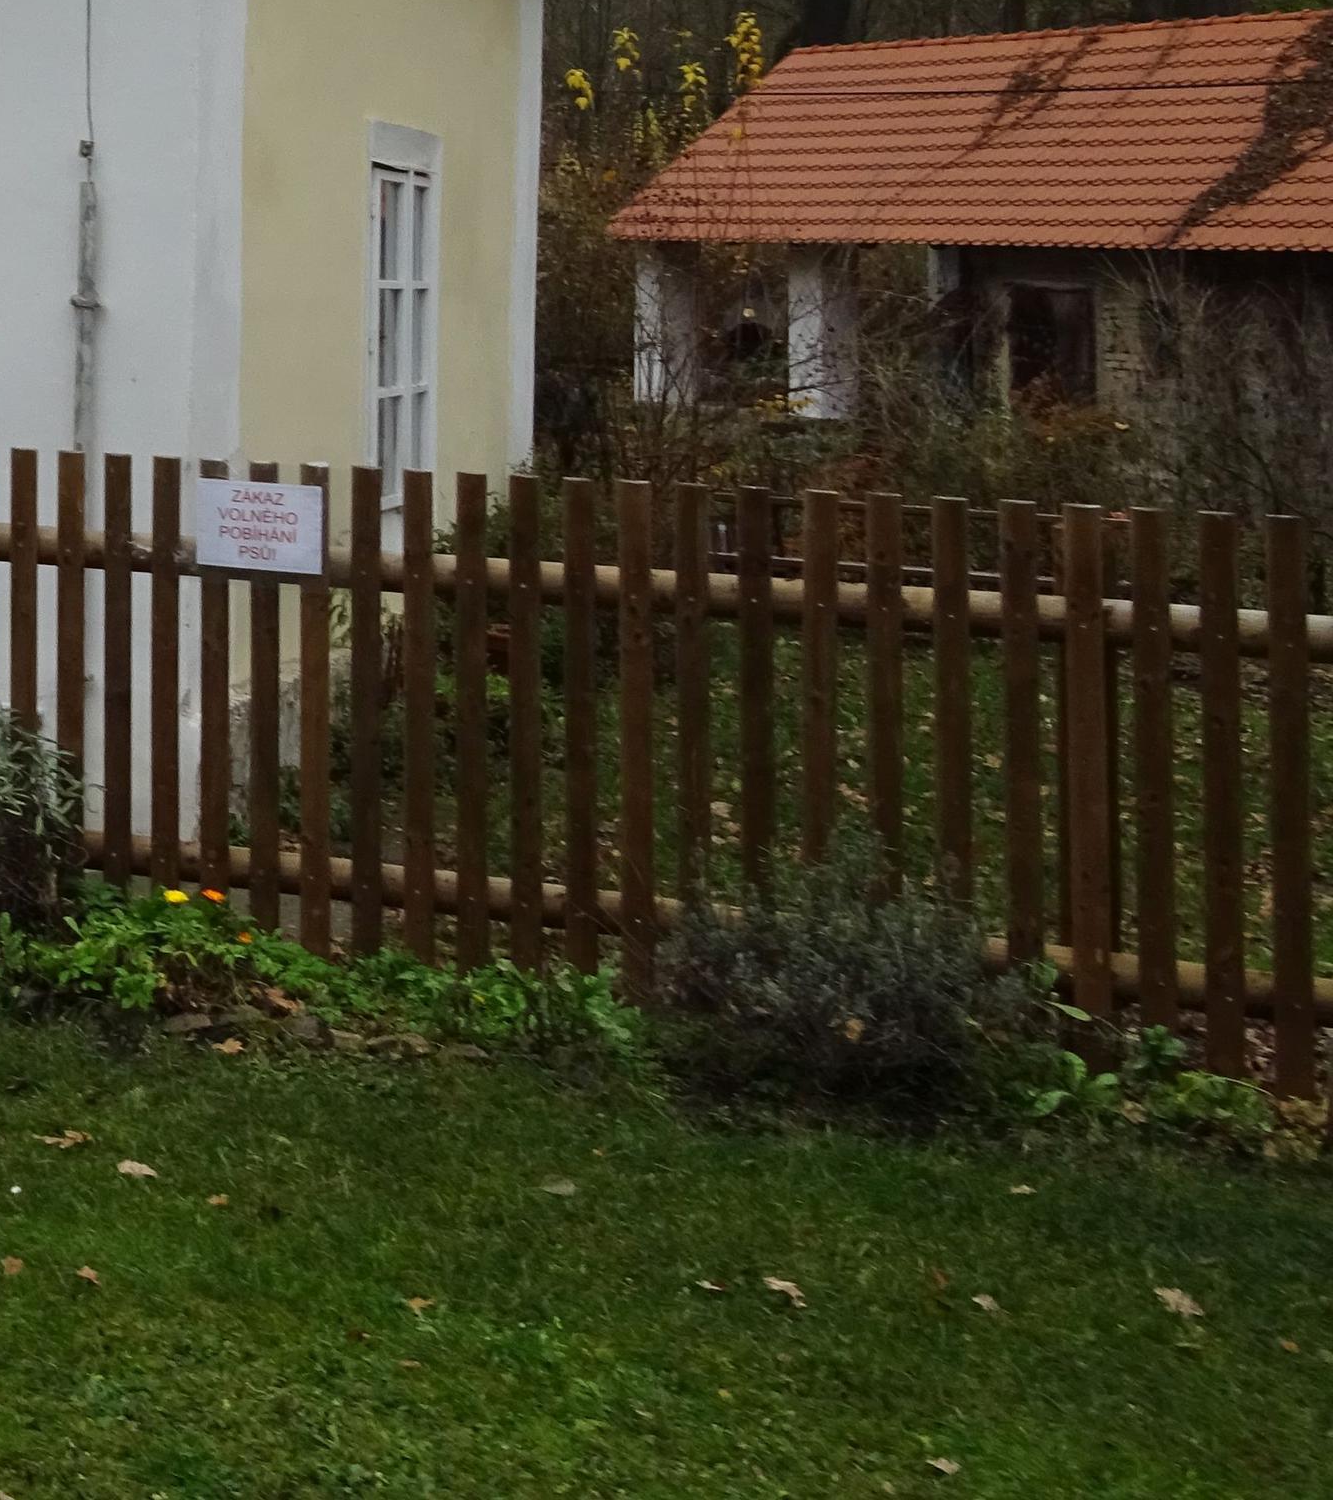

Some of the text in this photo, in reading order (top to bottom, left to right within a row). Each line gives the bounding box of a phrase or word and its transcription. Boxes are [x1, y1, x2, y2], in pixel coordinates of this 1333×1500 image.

[231, 488, 285, 506] ZÁKAZ
[217, 507, 299, 526] VOLNÉHO
[218, 525, 298, 544] POBÍHÁNÍ
